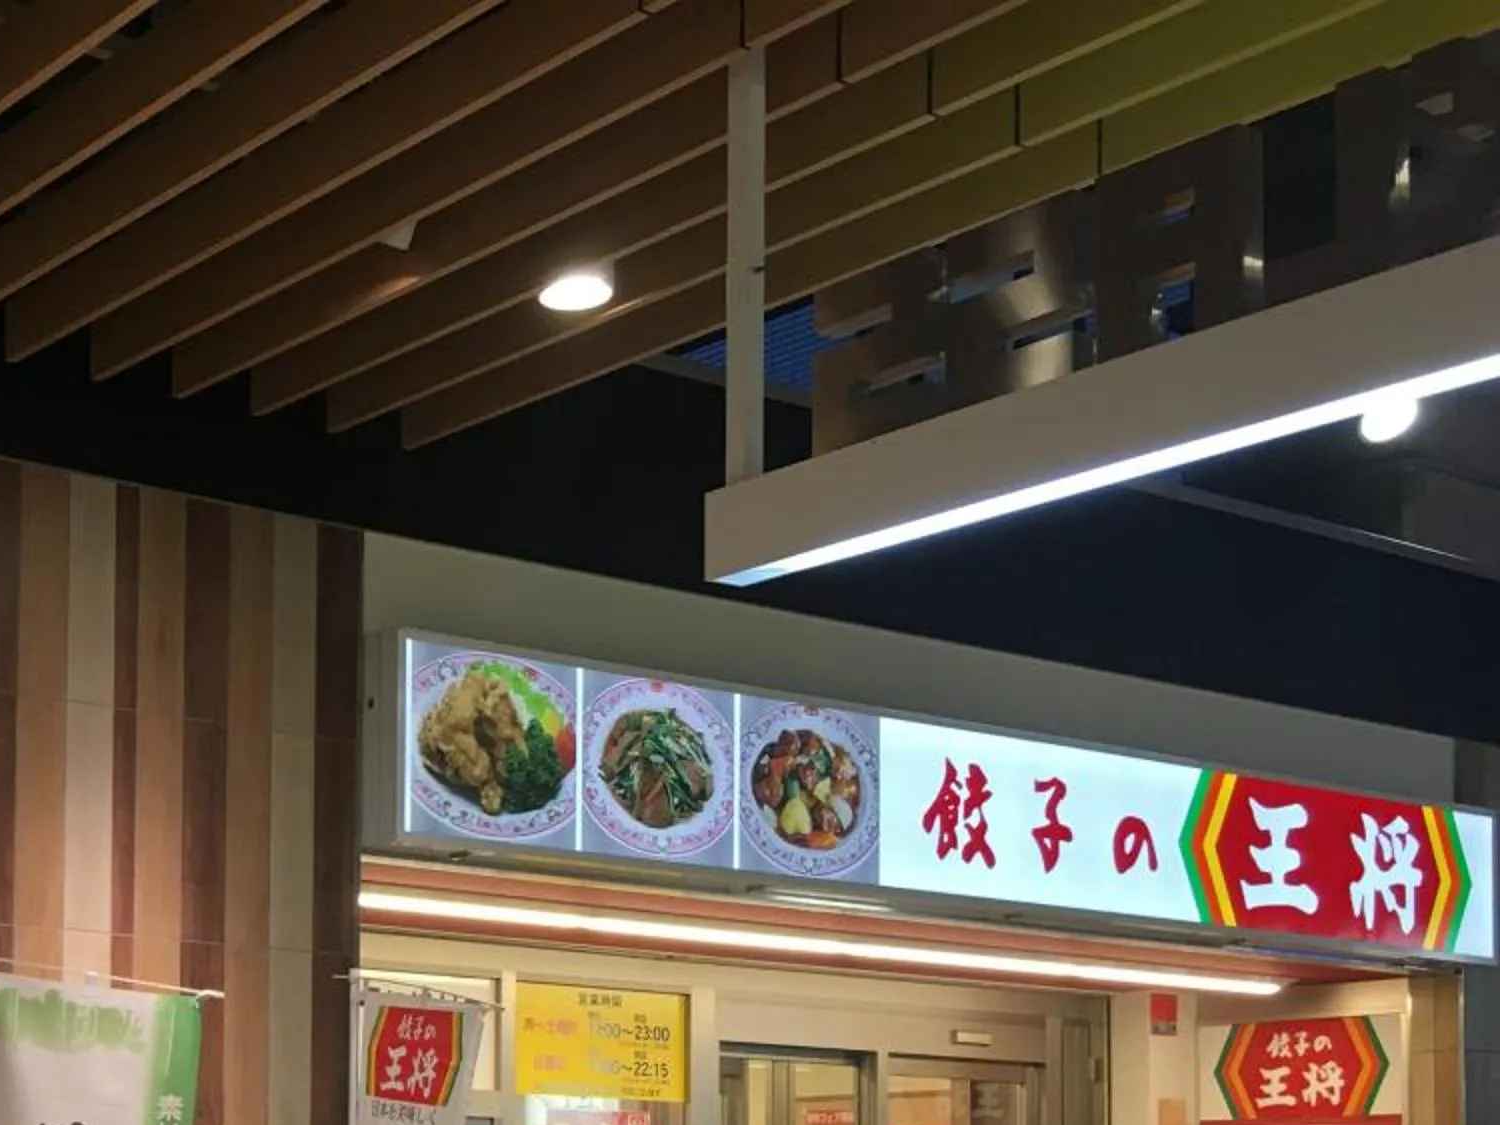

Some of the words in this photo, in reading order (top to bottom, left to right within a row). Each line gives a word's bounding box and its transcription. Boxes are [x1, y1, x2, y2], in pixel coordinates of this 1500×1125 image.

[922, 757, 1159, 875] 餃子の
[1239, 795, 1423, 934] 王将
[1266, 1030, 1333, 1058] 餃子の
[380, 1044, 439, 1099] 王将
[1255, 1059, 1345, 1109] 王将
